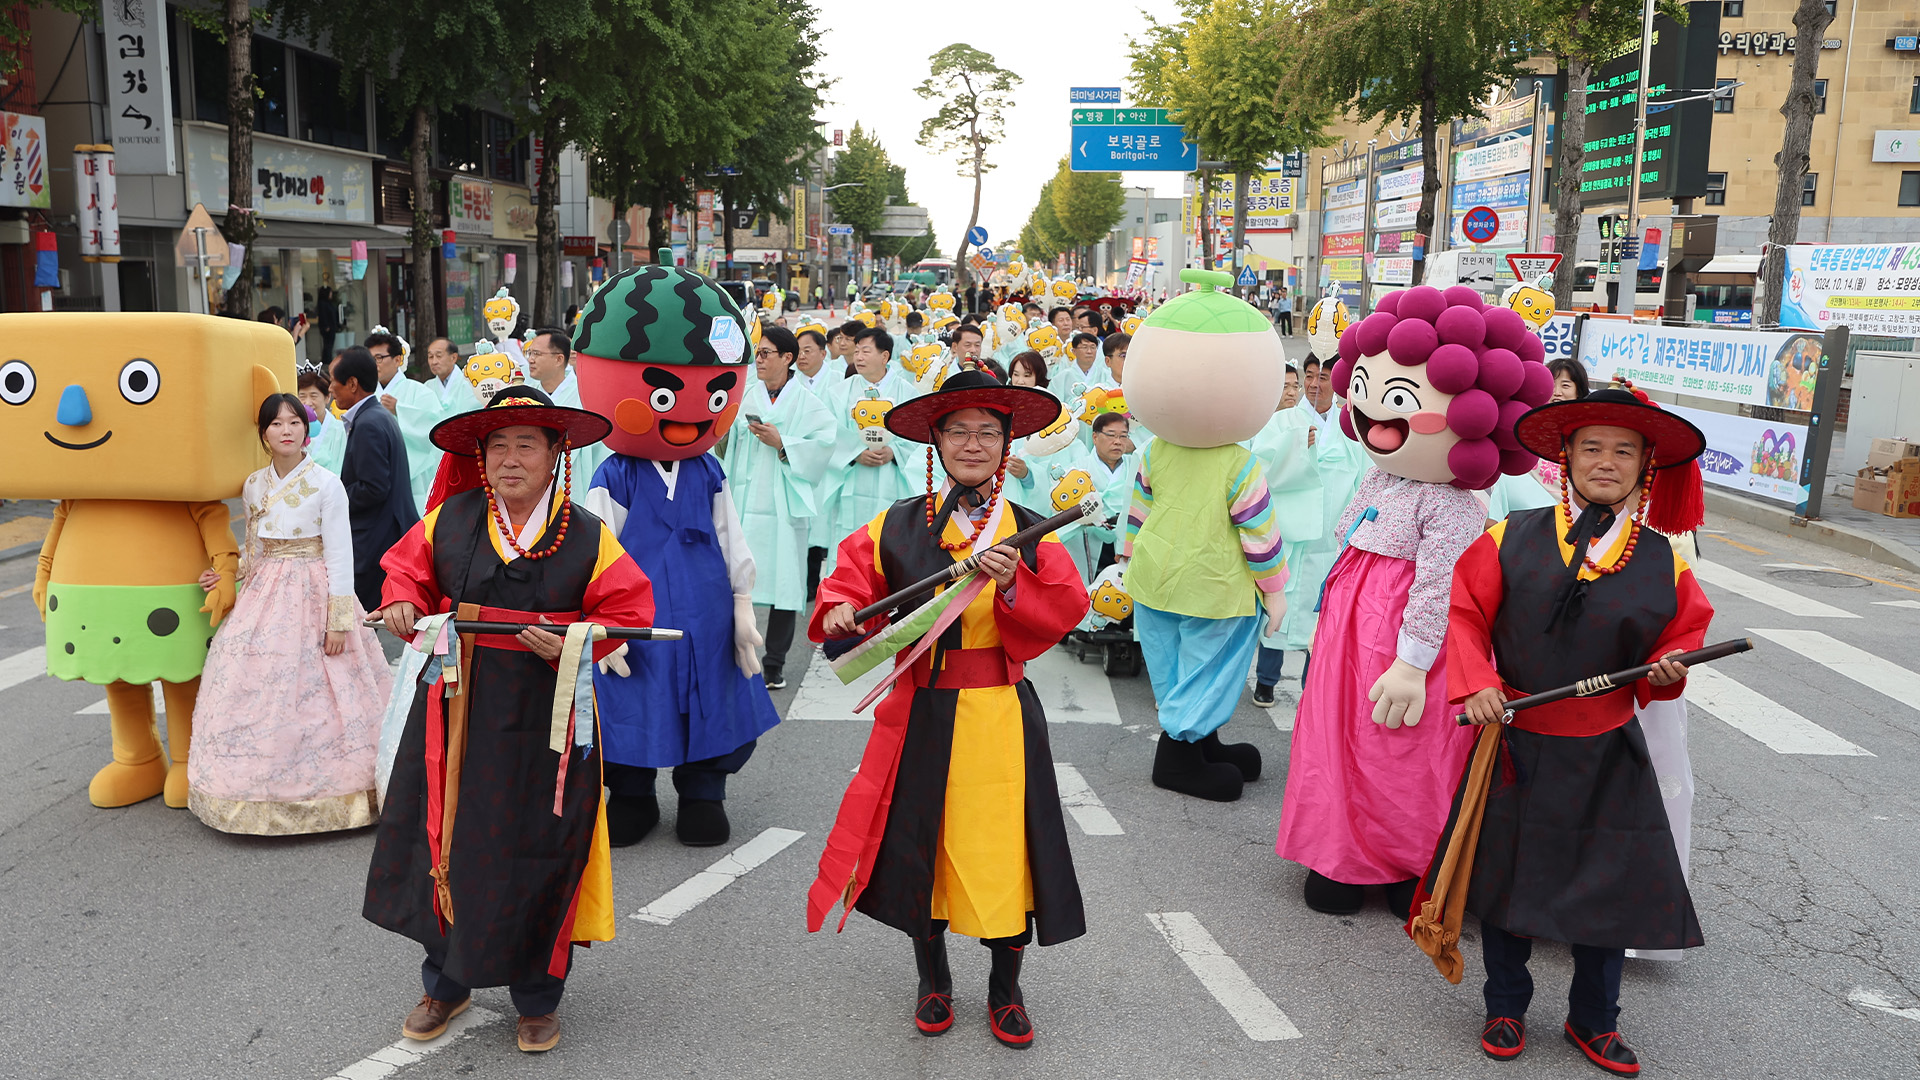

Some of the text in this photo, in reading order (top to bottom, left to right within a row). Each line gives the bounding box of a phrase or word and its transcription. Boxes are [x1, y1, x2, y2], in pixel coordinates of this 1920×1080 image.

[1718, 32, 1796, 55] 우리안과의
[1070, 90, 1121, 101] 터미널사거리
[1086, 111, 1104, 122] 영광
[1129, 111, 1147, 122] 아산
[118, 136, 161, 144] BOUTIQUE
[1107, 135, 1161, 149] 보릿골로
[1110, 151, 1158, 161] Boritgol-ro
[450, 181, 491, 220] 린부동산
[739, 215, 748, 228] P
[1462, 256, 1493, 266] 견인지역
[1810, 247, 1892, 271] 민족통일협의회
[1520, 260, 1546, 270] 양보
[1601, 332, 1768, 378] 바당길 제주전복뚝배기 개시
